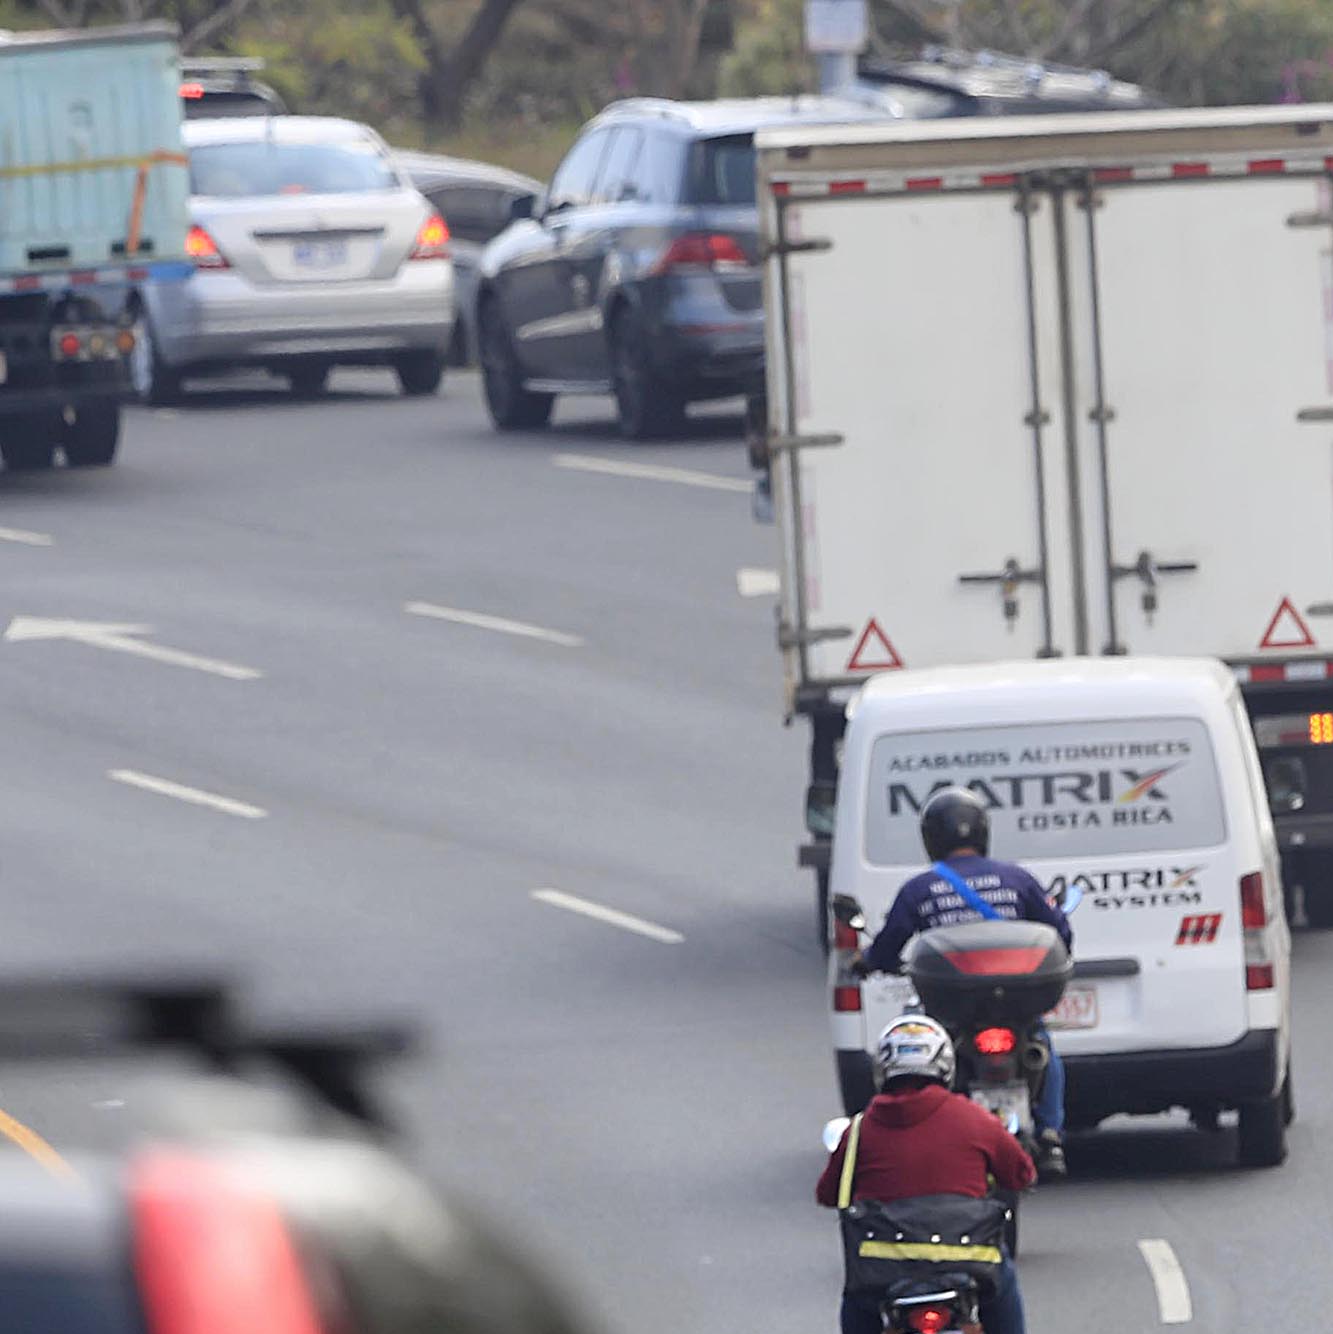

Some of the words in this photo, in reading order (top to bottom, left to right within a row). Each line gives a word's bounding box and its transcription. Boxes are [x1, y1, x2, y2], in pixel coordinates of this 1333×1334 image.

[890, 751, 1011, 772] ACABADOS
[1019, 739, 1192, 765] AUTOMOTRICES
[1018, 811, 1100, 833] COSTA
[1112, 806, 1174, 828] RICA
[1093, 892, 1203, 910] SYSTEM
